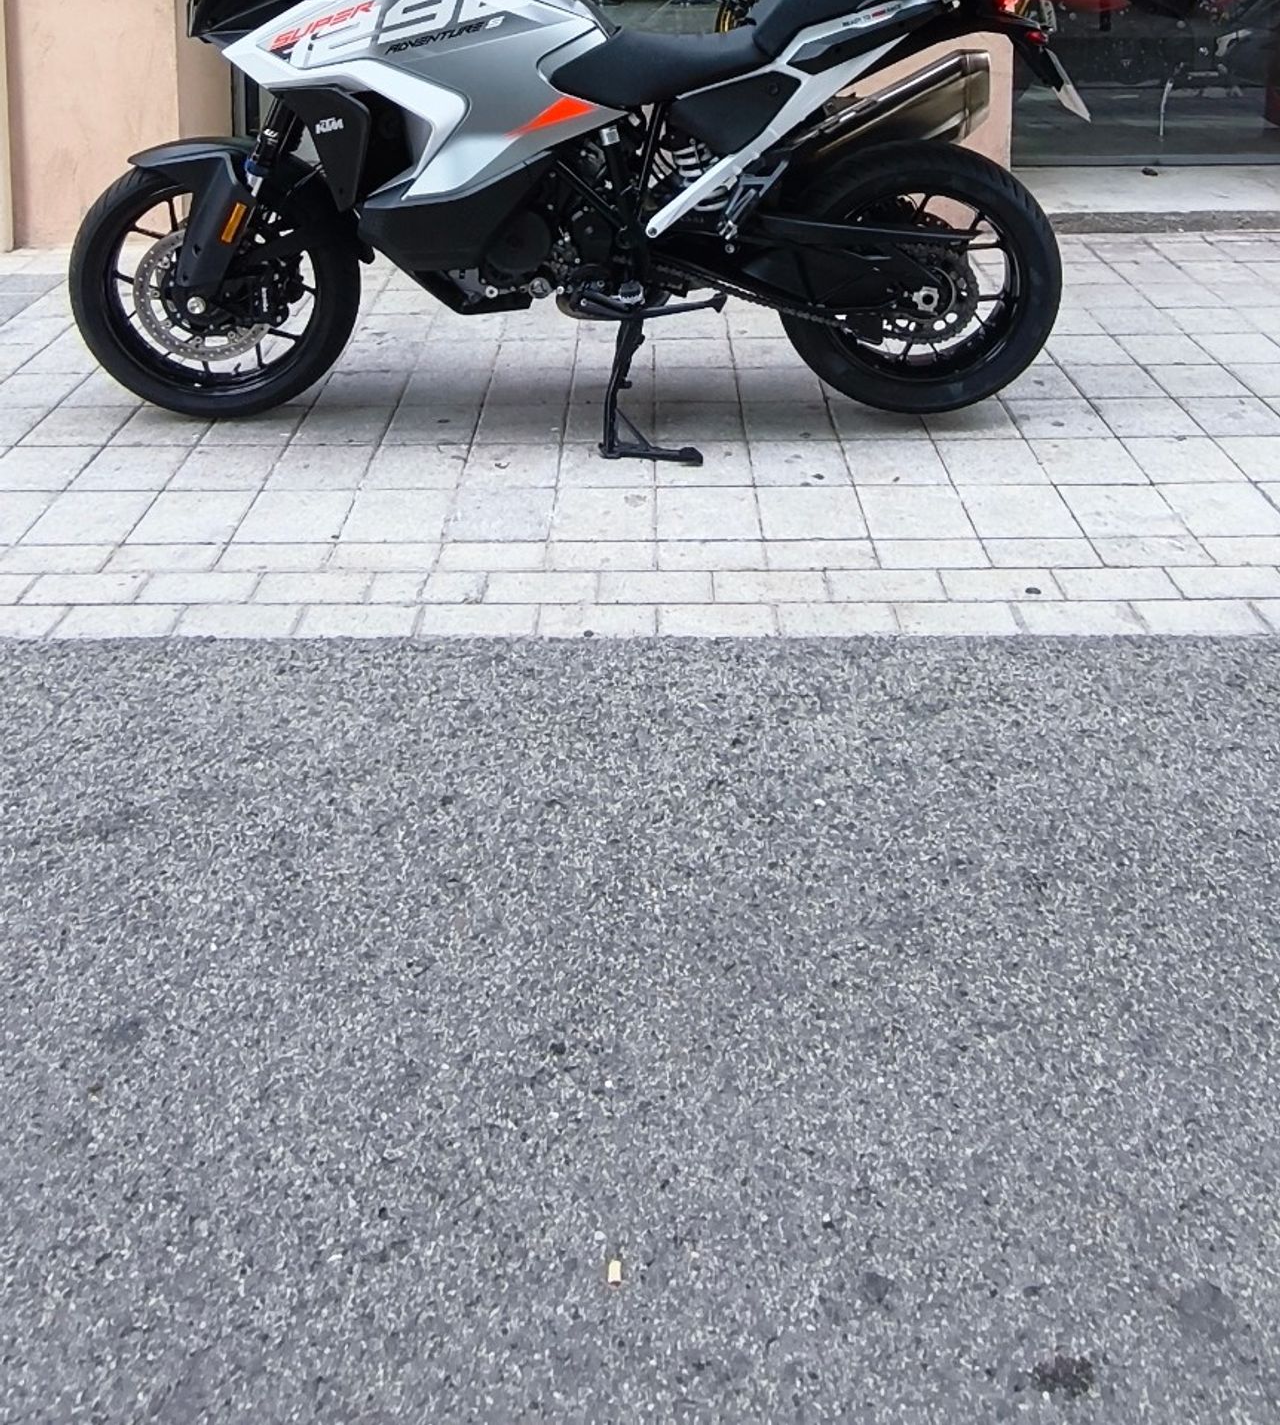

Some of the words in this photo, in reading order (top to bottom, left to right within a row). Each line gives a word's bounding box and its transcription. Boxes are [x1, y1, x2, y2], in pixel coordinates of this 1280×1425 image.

[273, 0, 376, 49] SUPER
[385, 21, 485, 55] ADVENTURE
[315, 117, 344, 134] KTM
